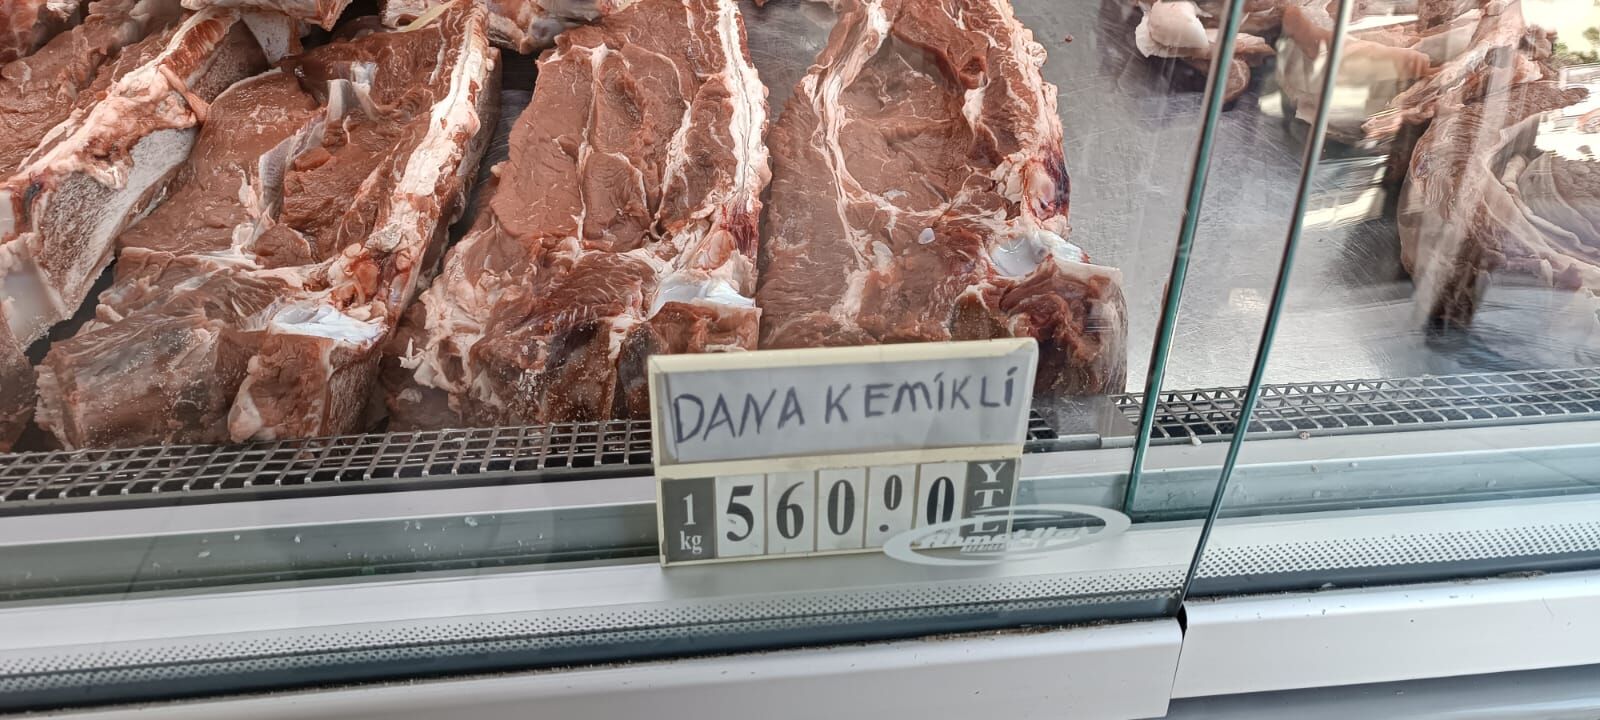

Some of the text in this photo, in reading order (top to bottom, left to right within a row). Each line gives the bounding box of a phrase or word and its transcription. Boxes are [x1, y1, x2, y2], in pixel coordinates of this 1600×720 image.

[673, 386, 805, 443] DANA
[682, 492, 697, 526] 1
[679, 530, 703, 554] kg
